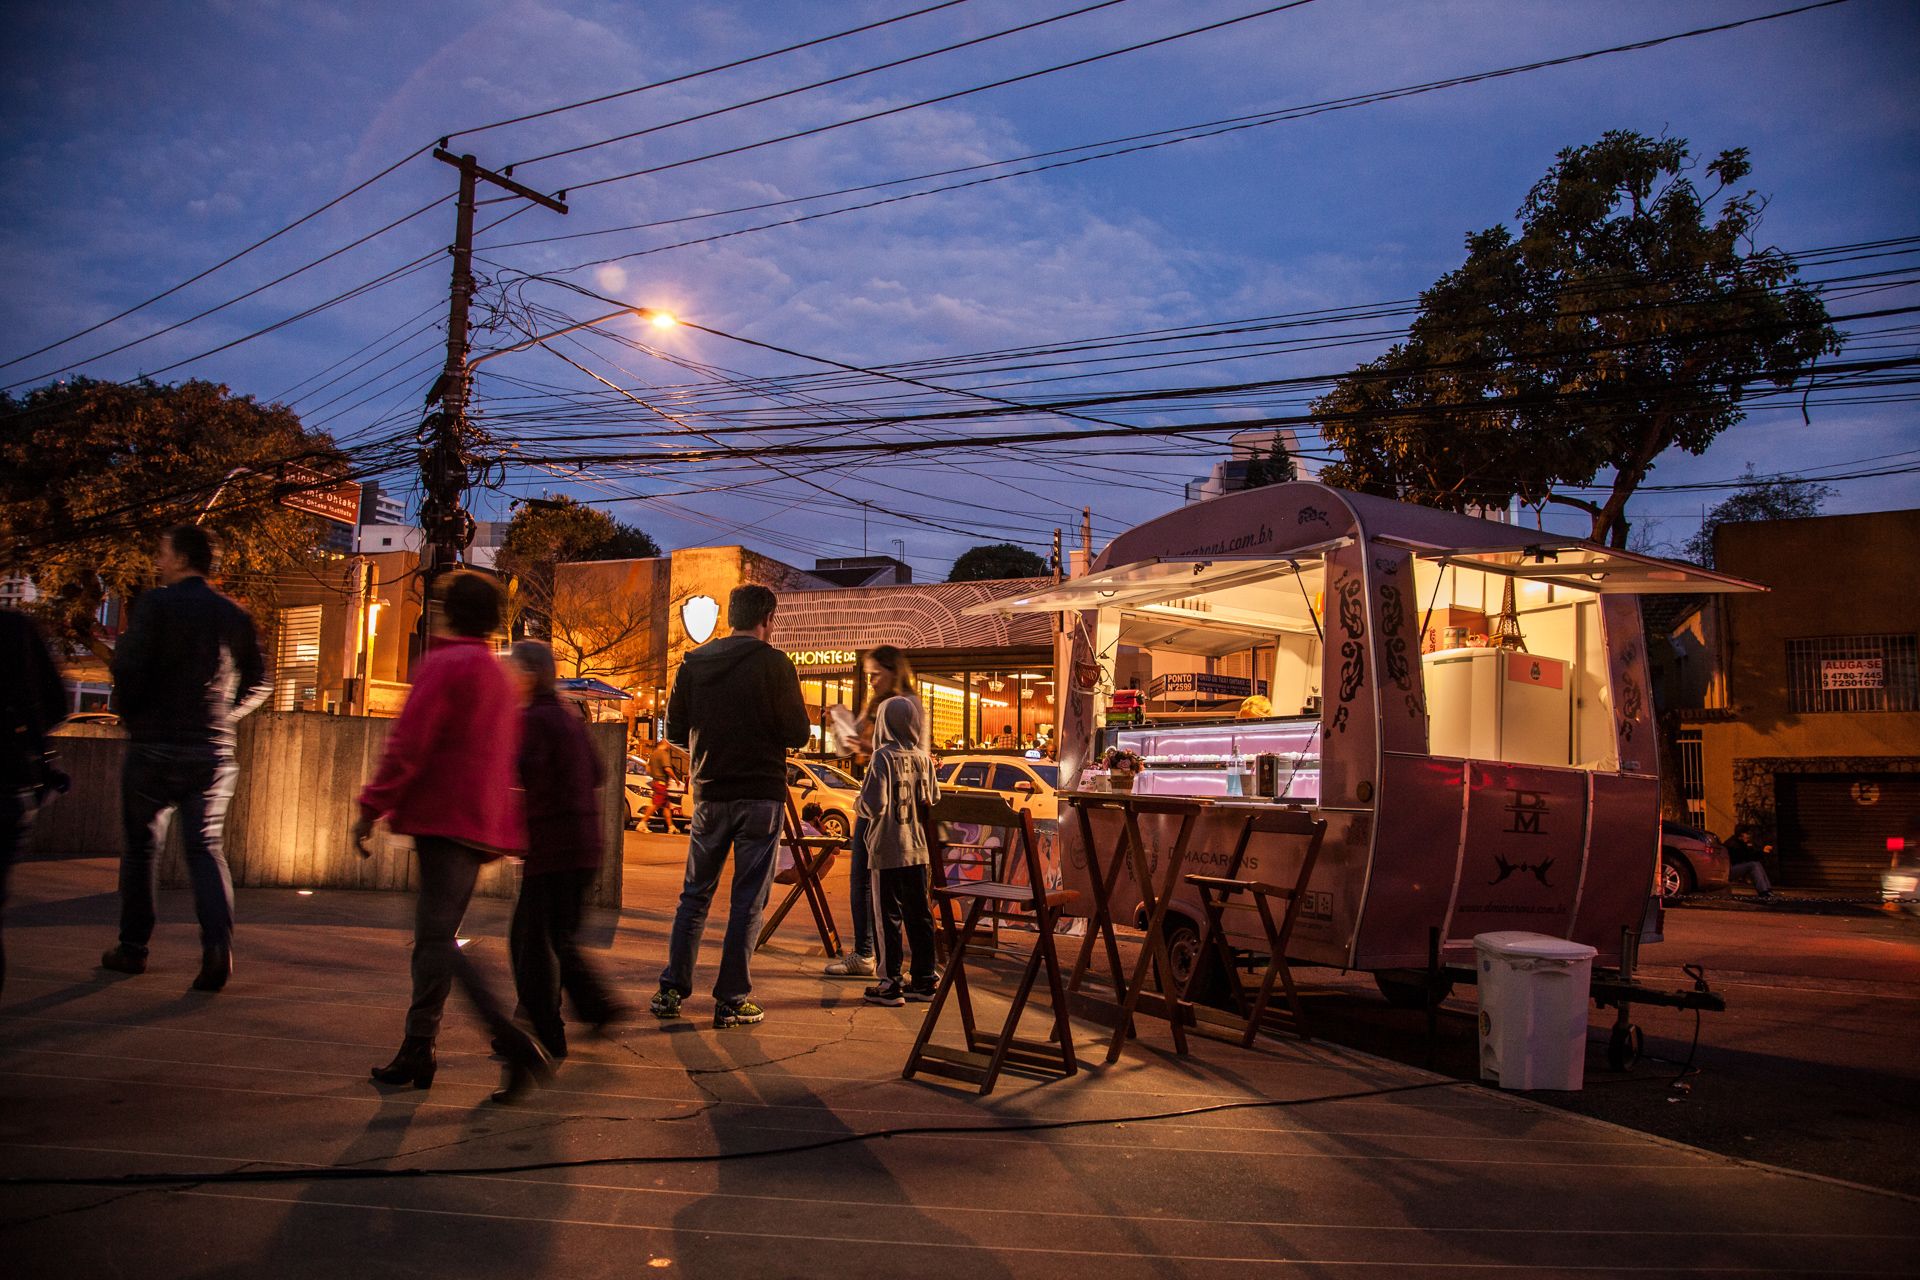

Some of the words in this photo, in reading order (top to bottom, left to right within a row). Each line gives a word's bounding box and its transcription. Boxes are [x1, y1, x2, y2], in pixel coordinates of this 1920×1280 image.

[326, 493, 357, 510] Ohtake
[1825, 660, 1881, 669] ALUGA-SE
[1167, 673, 1192, 683] PONTO
